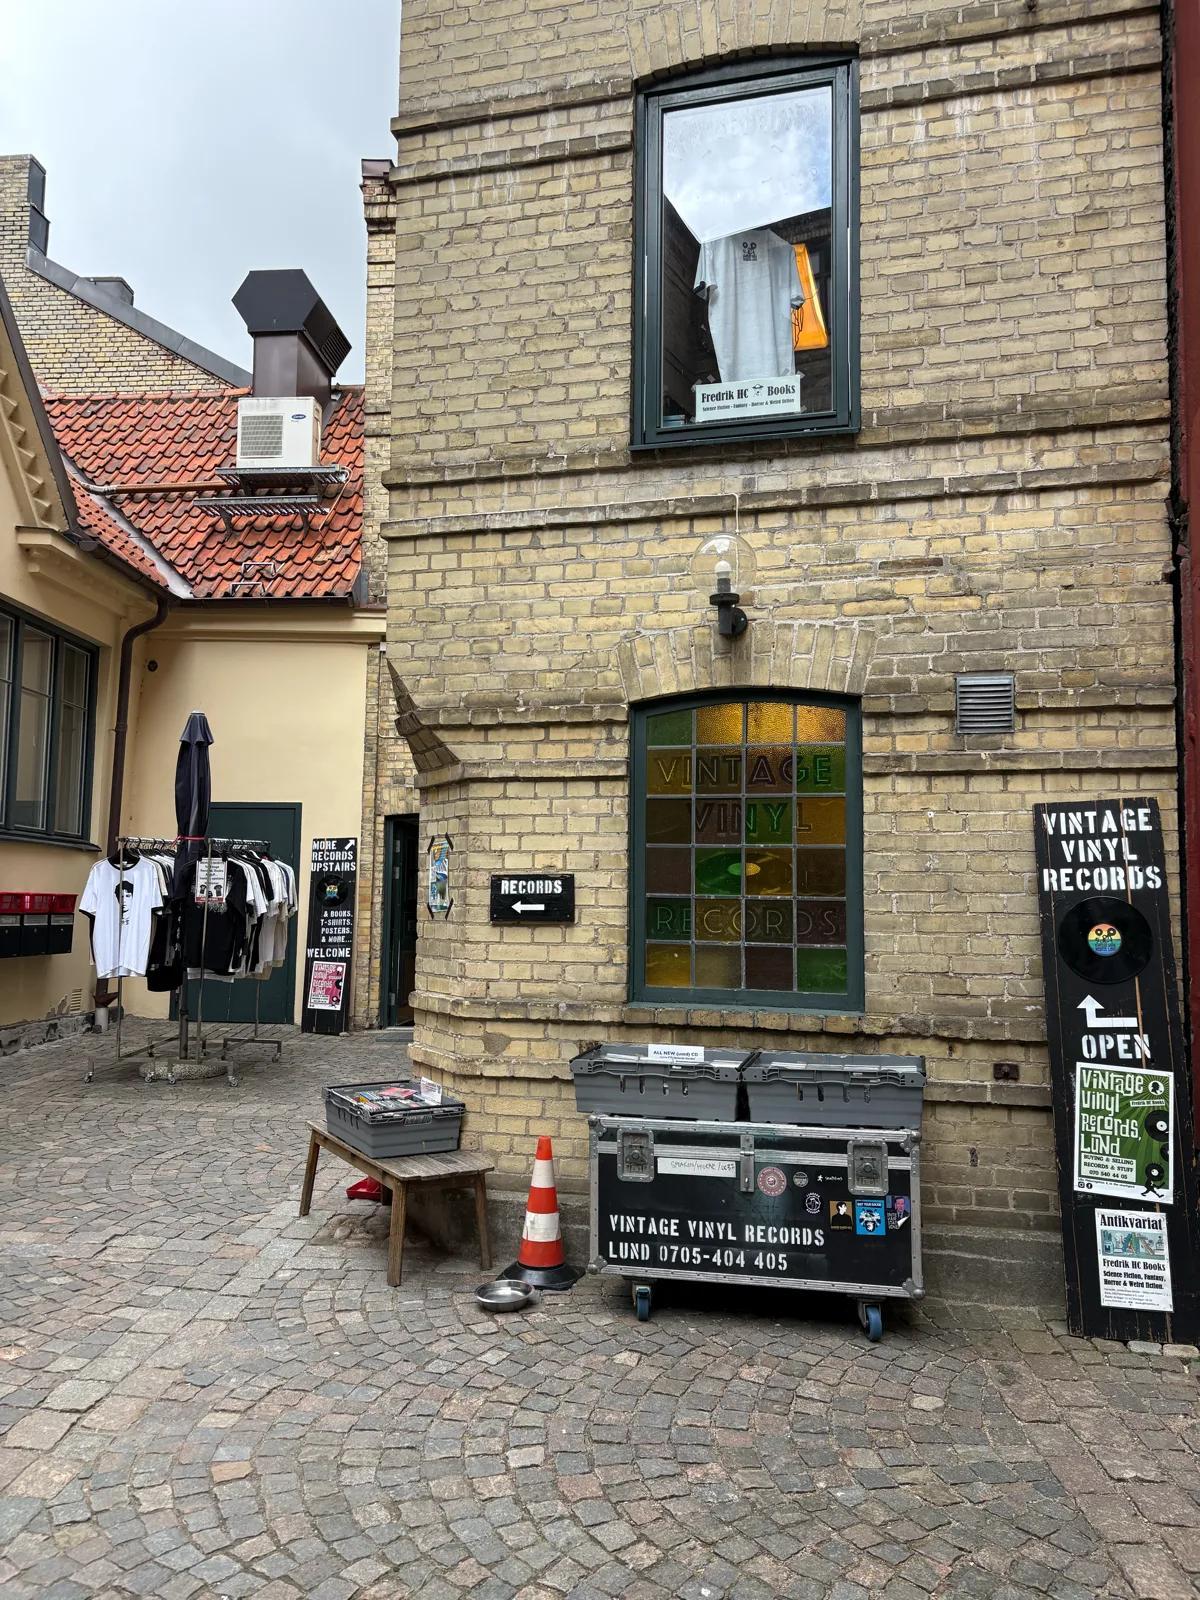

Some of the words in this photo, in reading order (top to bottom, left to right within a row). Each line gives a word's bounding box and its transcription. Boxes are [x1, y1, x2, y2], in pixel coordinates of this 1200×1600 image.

[702, 390, 734, 403] Fredrik
[737, 388, 749, 399] HC
[767, 384, 796, 396] Books
[655, 754, 832, 788] VINTAGE
[688, 802, 813, 837] VINYL
[1042, 808, 1153, 835] VINTAGE
[312, 840, 337, 850] MORE
[1061, 838, 1138, 863] VINYL
[312, 851, 353, 861] RECORDS
[311, 862, 356, 872] UPSTAIRS
[501, 880, 562, 895] RECORDS
[1043, 866, 1162, 891] RECORDS
[655, 906, 837, 937] RECORDS
[307, 947, 351, 958] WELCOME
[1081, 1033, 1151, 1059] OPEN
[1083, 1161, 1109, 1169] RECORDS
[609, 1214, 680, 1237] VINTAGE
[687, 1219, 737, 1241] VINYL
[745, 1224, 825, 1247] RECORDS
[1100, 1214, 1163, 1231] Antikvariat
[609, 1241, 650, 1260] LUND
[660, 1245, 745, 1268] 0705-404
[754, 1252, 788, 1271] 405
[1103, 1258, 1129, 1269] Fredrik
[1131, 1260, 1141, 1269] HC
[1143, 1261, 1166, 1271] Books
[1103, 1270, 1122, 1278] Science
[1103, 1278, 1121, 1286] Horror
[1122, 1279, 1127, 1287] &
[1129, 1280, 1144, 1288] Weird
